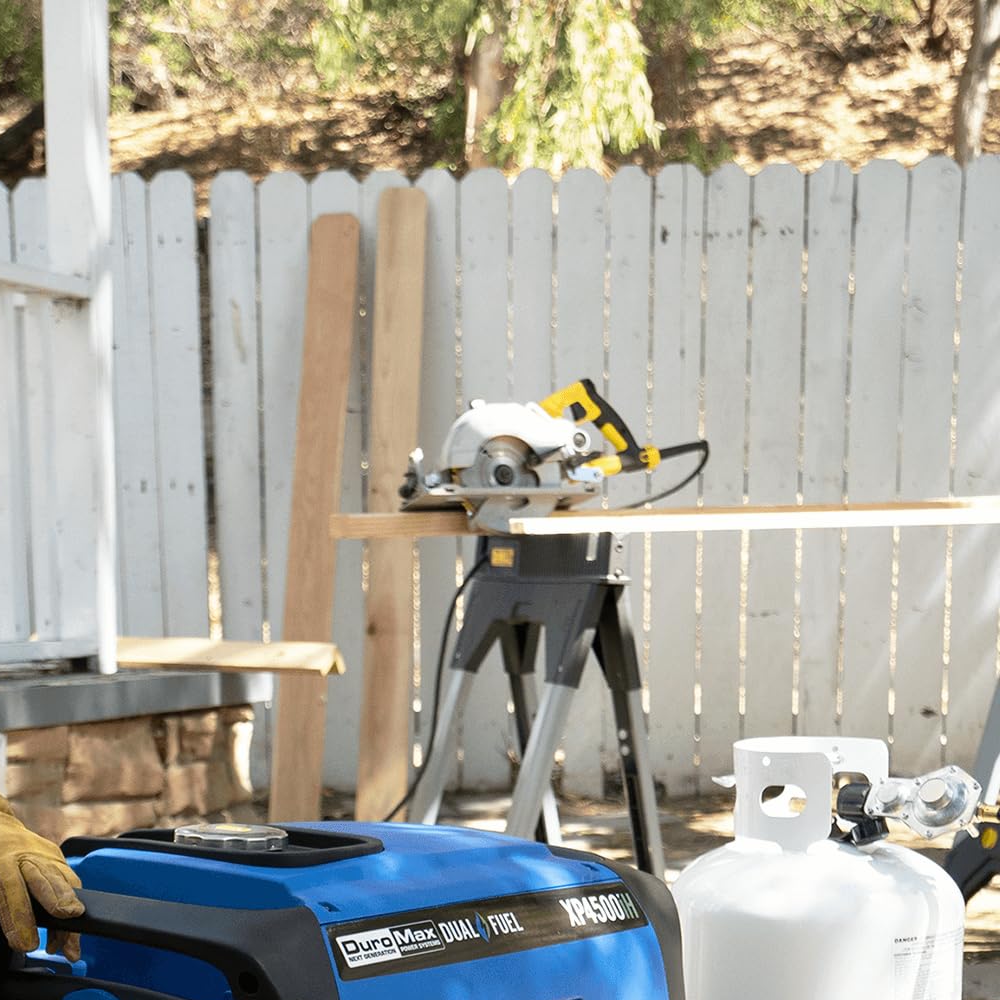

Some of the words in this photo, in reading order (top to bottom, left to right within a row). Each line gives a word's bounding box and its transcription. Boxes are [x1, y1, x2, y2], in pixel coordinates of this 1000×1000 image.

[559, 892, 639, 928] XP4500iH
[342, 928, 438, 955] DuroMax
[438, 917, 480, 944] DUAL
[487, 912, 524, 936] FUEL
[348, 954, 363, 963] NEXT
[363, 949, 397, 960] GENERATION
[400, 944, 418, 953] POWER
